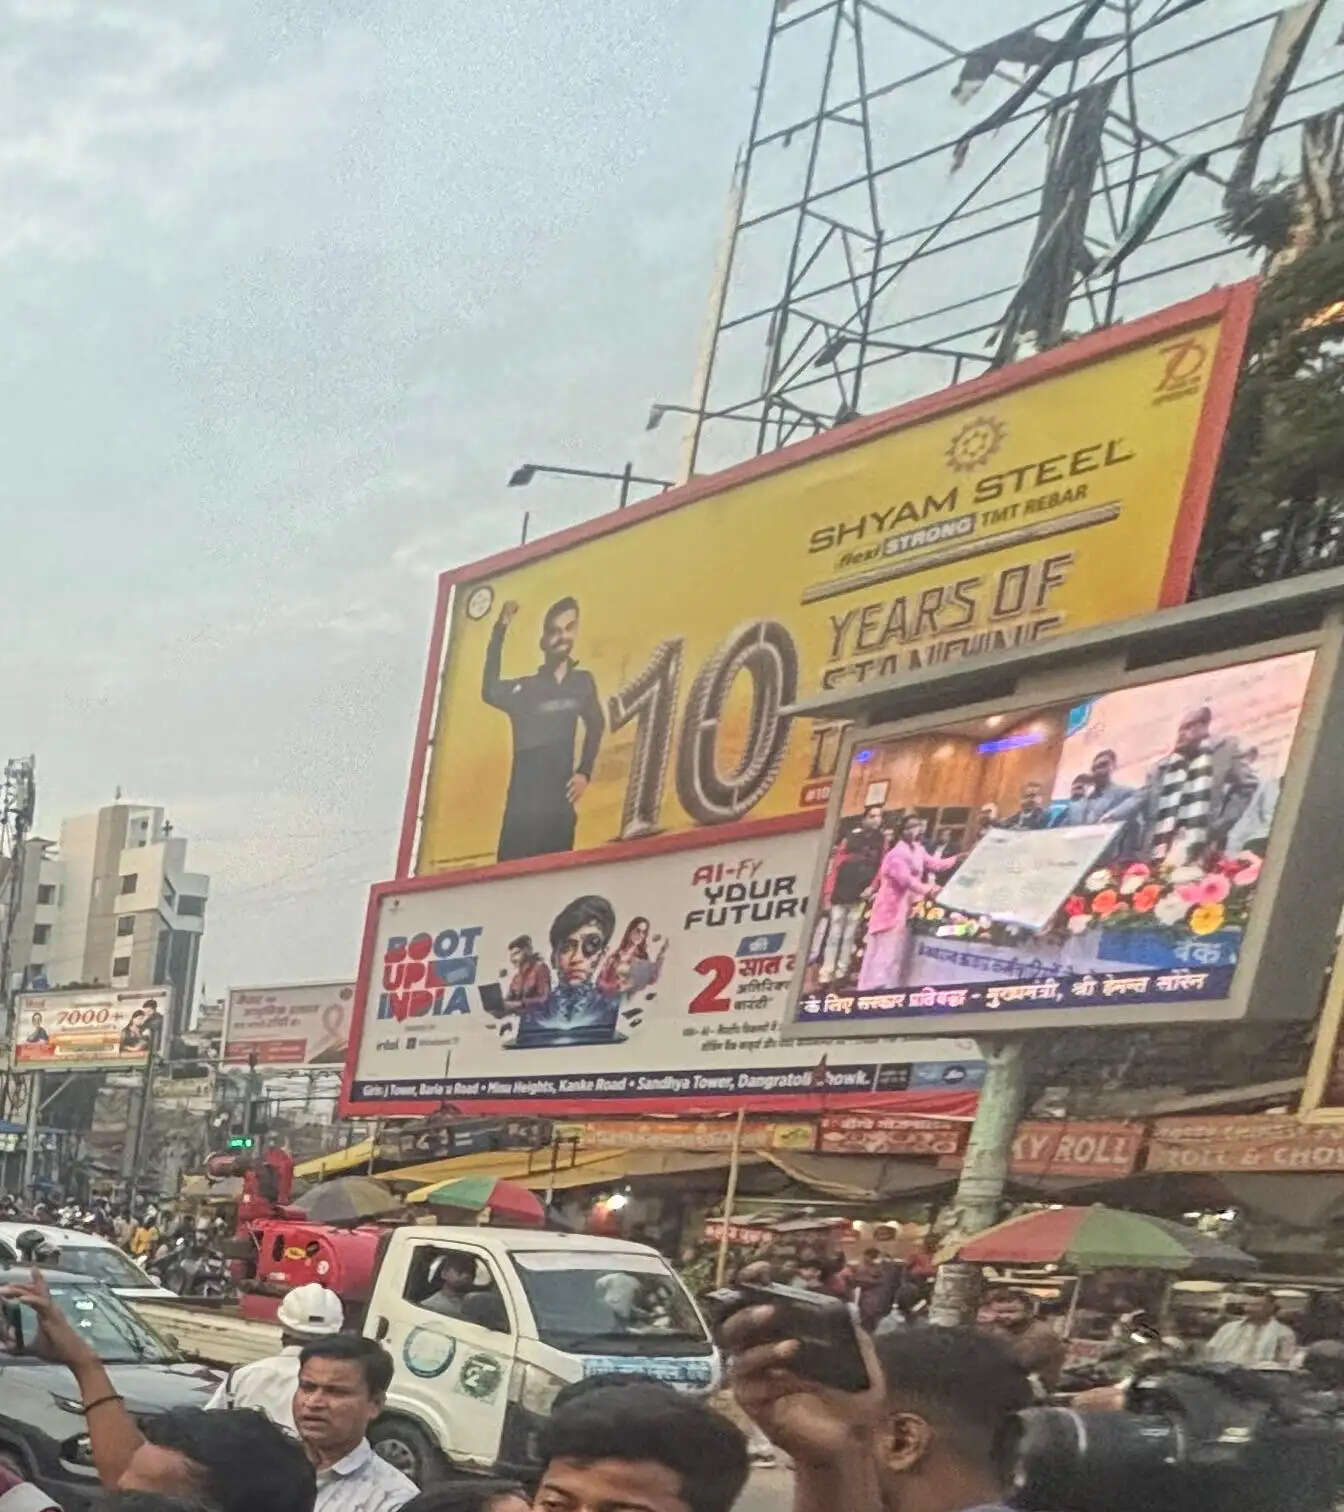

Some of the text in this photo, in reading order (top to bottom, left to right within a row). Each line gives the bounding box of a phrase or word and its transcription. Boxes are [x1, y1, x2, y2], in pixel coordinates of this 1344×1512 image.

[809, 438, 1137, 554] SHYAM STEEL
[884, 517, 973, 556] STRONG
[981, 503, 1022, 528] TMT
[1024, 484, 1088, 516] REBAR
[829, 551, 1075, 661] YEARS OF
[608, 617, 798, 841] 10
[692, 858, 763, 886] AI-FY
[704, 876, 796, 905] YOUR
[384, 926, 484, 964] BOOT
[376, 984, 471, 1023] INDIA
[688, 955, 782, 1014] 2 साल
[823, 993, 855, 1014] लिए
[512, 1080, 557, 1097] Heights,
[558, 1076, 595, 1093] Kanke
[596, 1075, 628, 1091] Road
[636, 1074, 690, 1093] Sandhya
[693, 1072, 734, 1091] Tower,
[816, 1069, 871, 1087] howk.
[1013, 1134, 1132, 1164] KY ROLL
[1272, 1146, 1344, 1167] CHO
